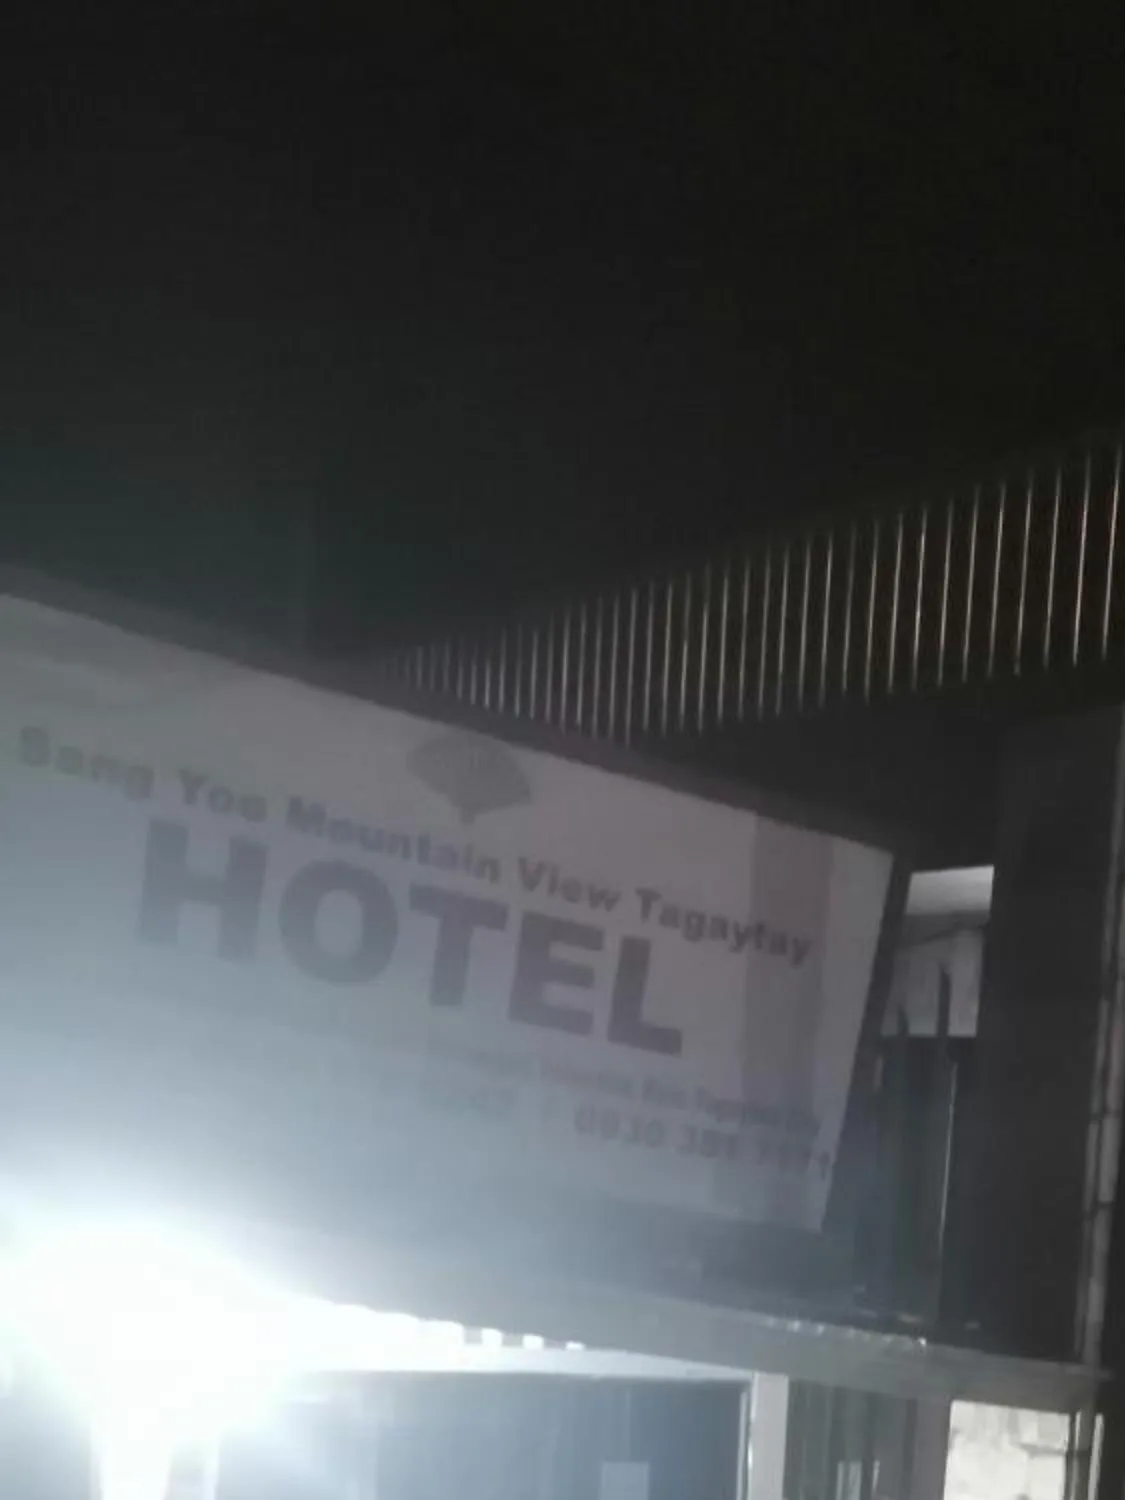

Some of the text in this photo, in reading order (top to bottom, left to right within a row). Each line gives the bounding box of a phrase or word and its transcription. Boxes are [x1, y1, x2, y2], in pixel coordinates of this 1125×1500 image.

[136, 817, 684, 1057] HOTEL
[286, 795, 502, 884] Mountain
[516, 854, 620, 913] View
[634, 885, 814, 968] Tagaytay
